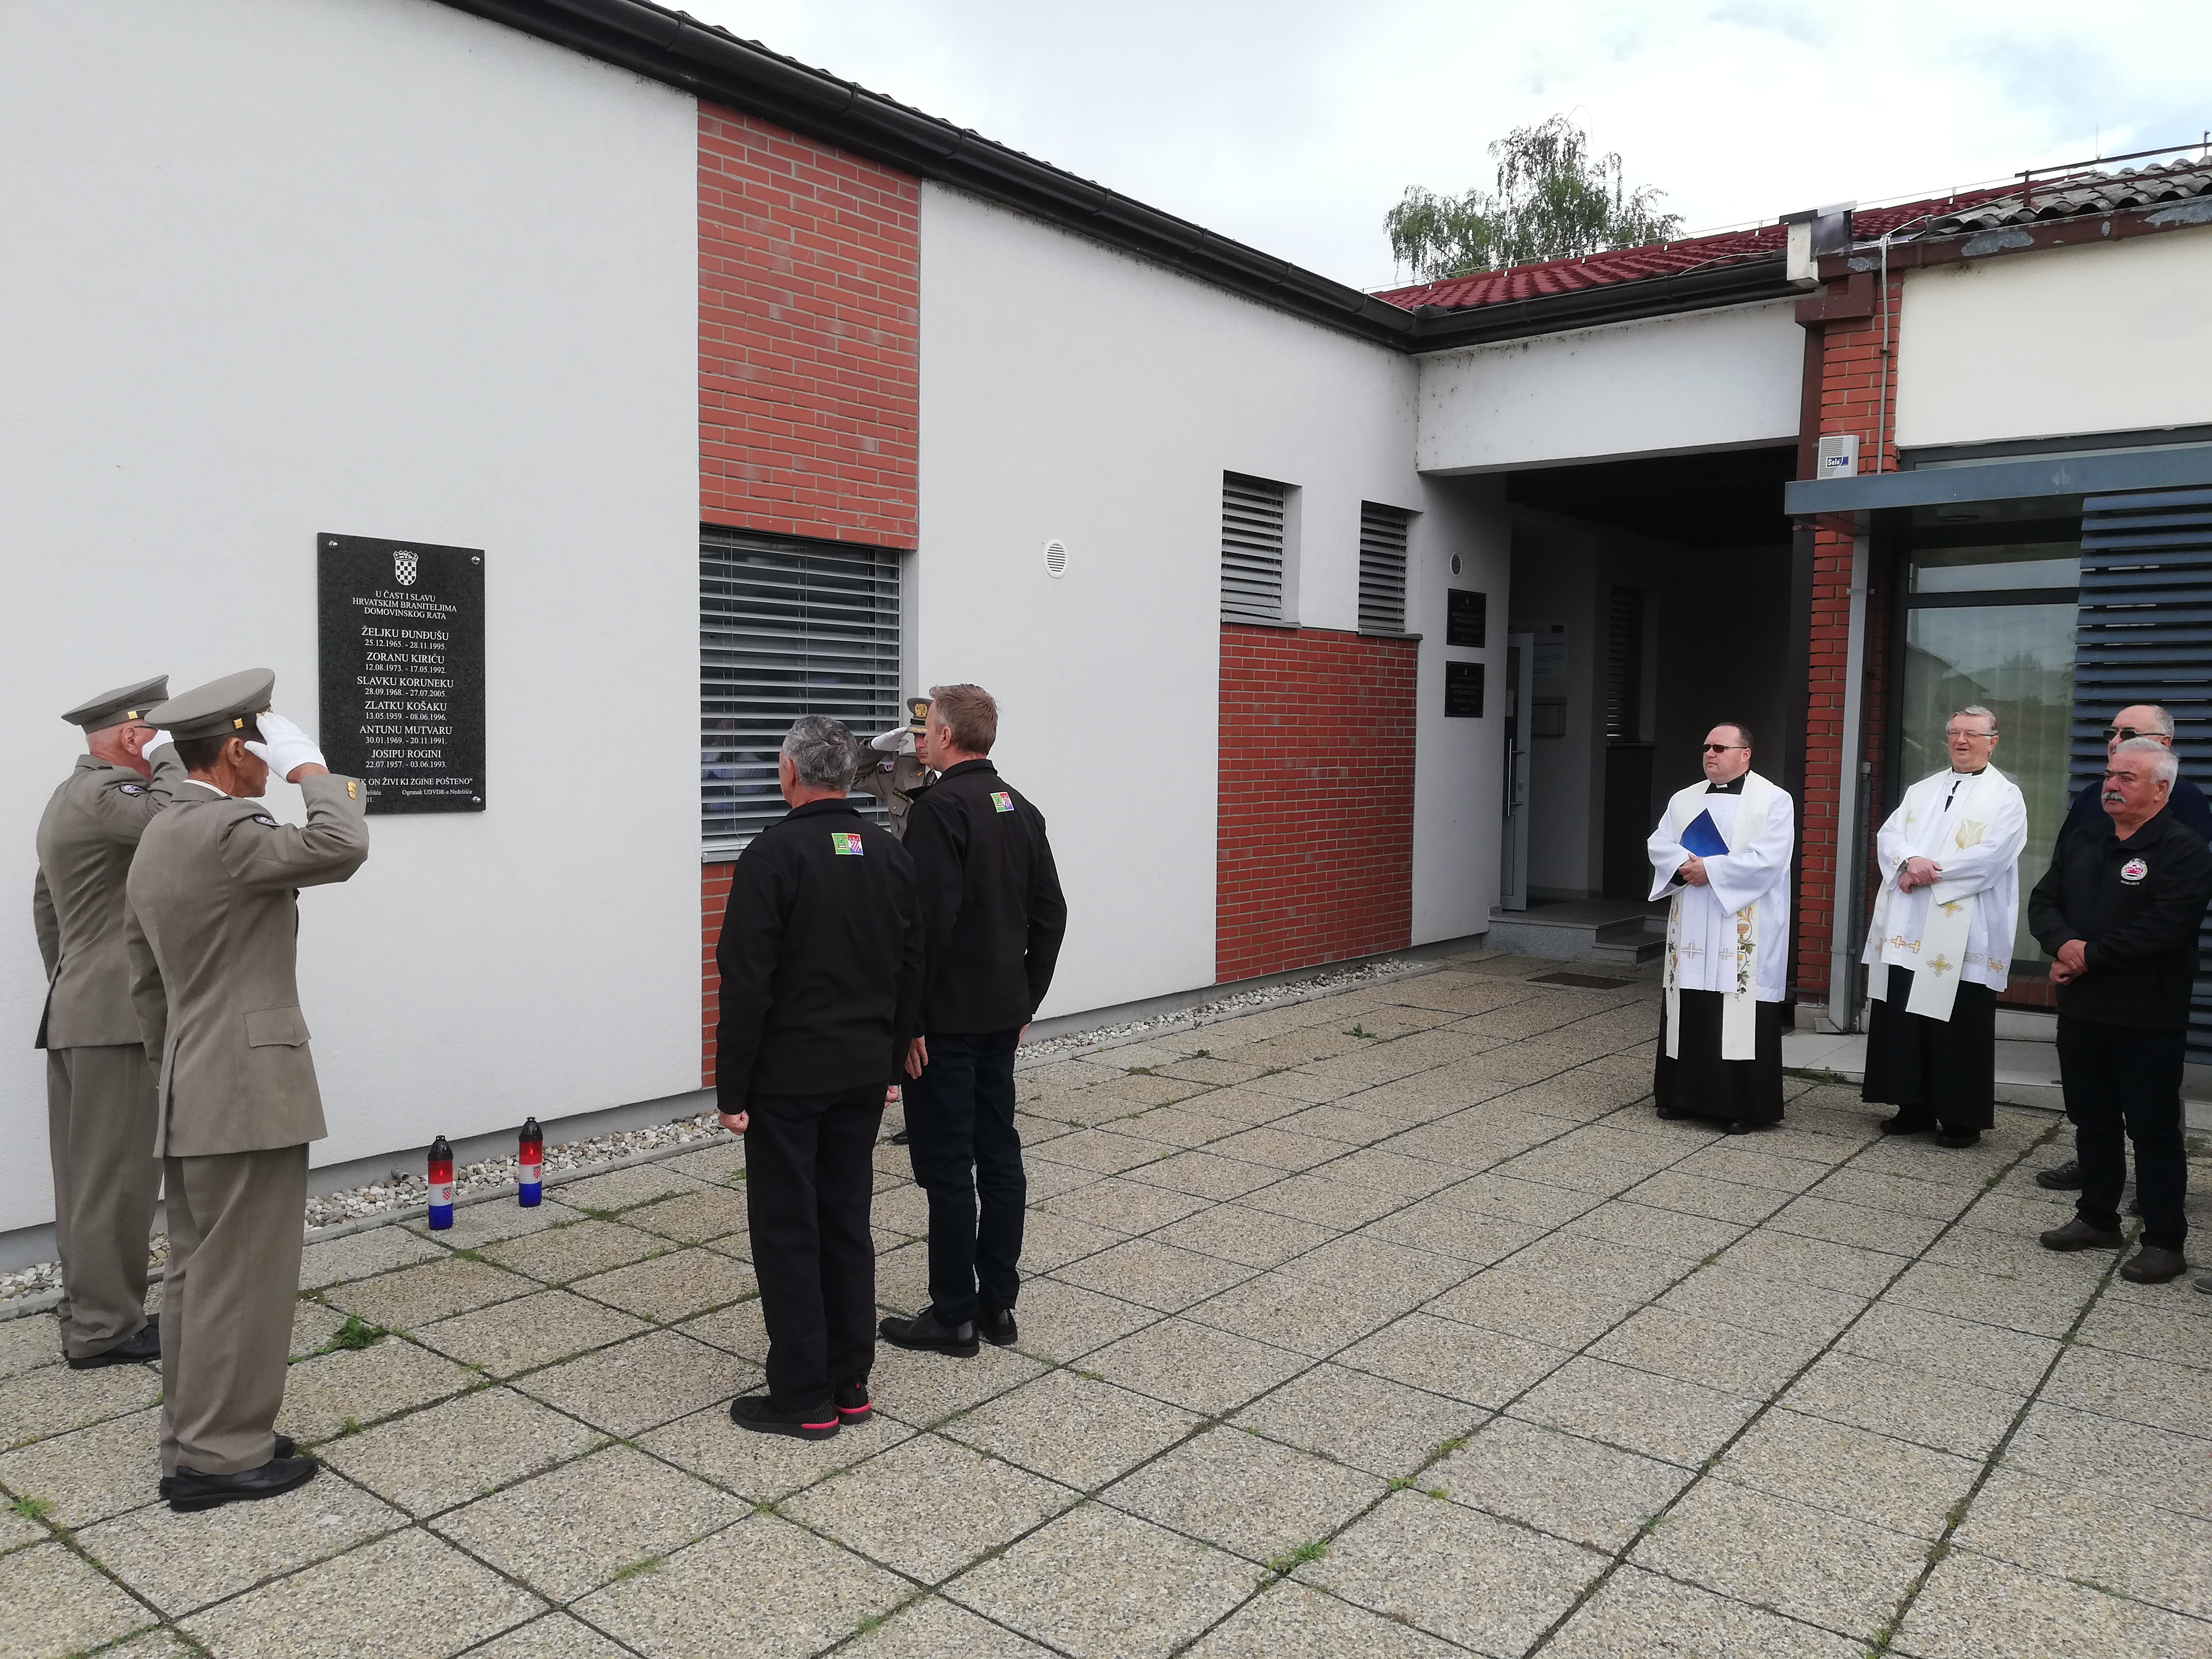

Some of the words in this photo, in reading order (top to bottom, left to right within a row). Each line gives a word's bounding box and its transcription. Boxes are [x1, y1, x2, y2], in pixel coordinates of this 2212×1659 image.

[383, 589, 404, 600] ČAST
[410, 593, 436, 602] SLAVU
[352, 597, 398, 608] HRVATSKIM
[400, 601, 457, 612] BRANITELJIMA
[364, 607, 425, 618] DOMOVINSKOG
[427, 612, 446, 620] RATA
[361, 625, 399, 637] ŽELJKU
[401, 629, 449, 641] ĐUNĐUŠU
[364, 639, 403, 648] 25.12.1965.
[409, 641, 447, 650] 28.11.1995.
[366, 652, 409, 662] ZORANU
[411, 653, 445, 664] KIRIĆU
[366, 663, 404, 672] 12.08.1973.
[410, 665, 447, 674] 17.05.1992.
[357, 676, 397, 685] SLAVKU
[399, 678, 454, 688] KORUNEKU
[365, 688, 404, 696] 28.09.1968.
[409, 689, 447, 697] 27.07.2005.
[364, 701, 404, 710] ZLATKU
[406, 700, 447, 711] KOŠAKU
[366, 712, 404, 720] 13.05.1959.
[359, 725, 402, 734] ANTUNU
[405, 726, 453, 735] MUTVARU
[371, 749, 405, 758] JOSIPU
[407, 750, 441, 758] ROGINI
[382, 777, 398, 785] ŽIVI
[435, 777, 473, 785] POŠTENO"
